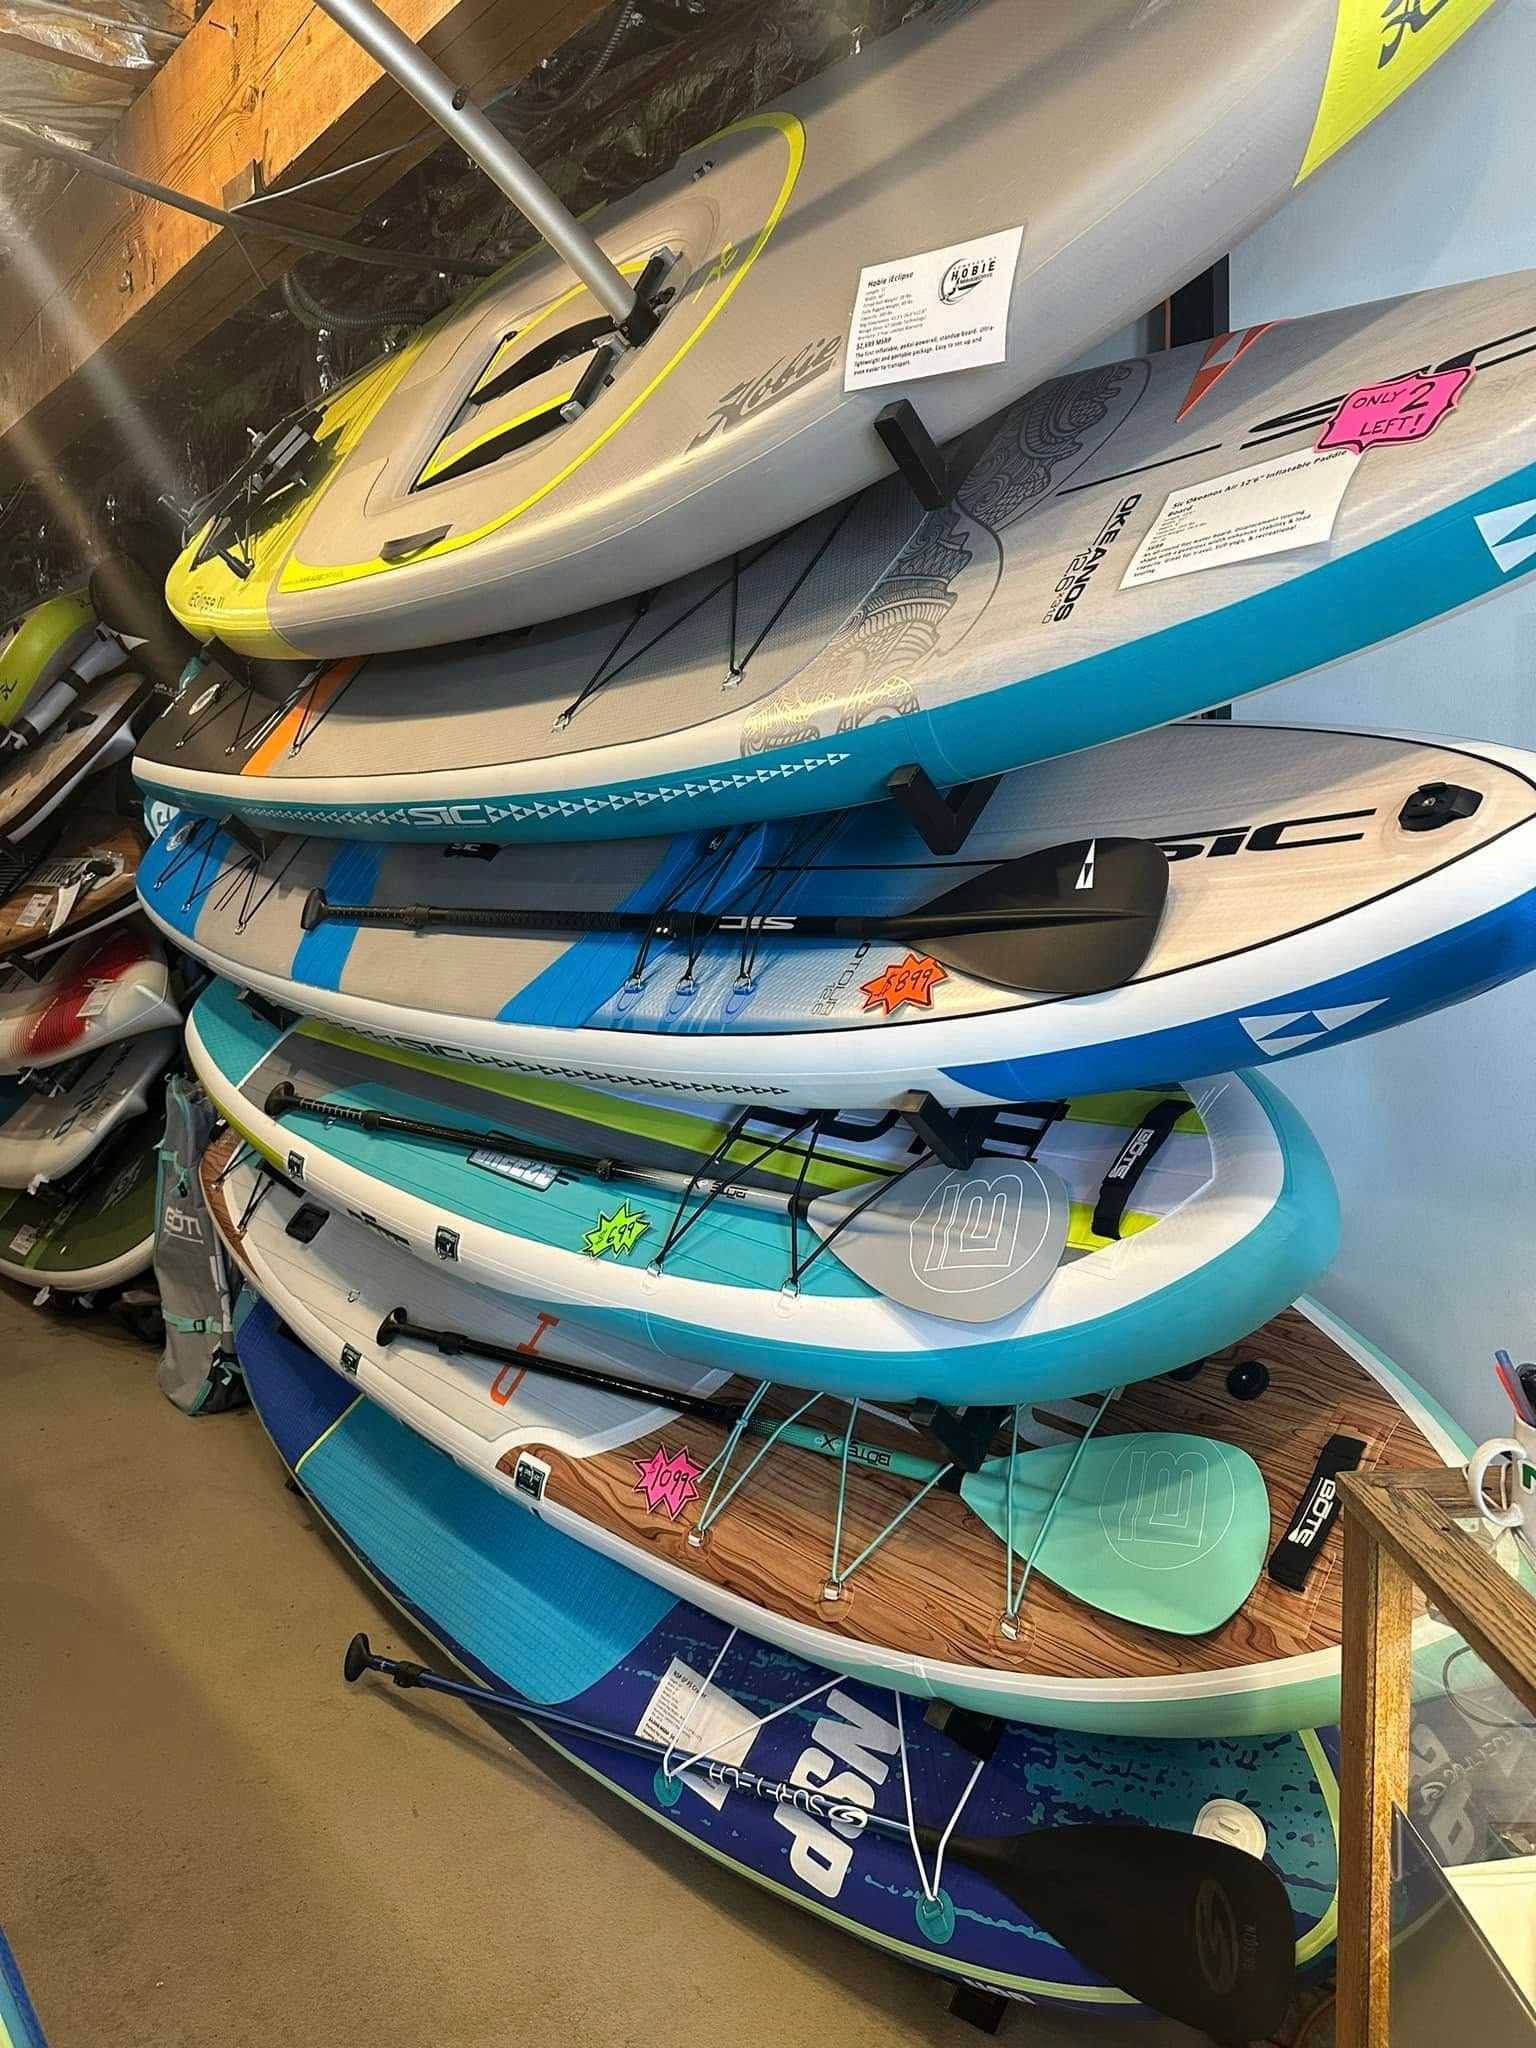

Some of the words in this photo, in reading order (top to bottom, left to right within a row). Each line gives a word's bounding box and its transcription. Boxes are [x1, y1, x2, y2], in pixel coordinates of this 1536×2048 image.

[951, 261, 996, 280] HOBIE
[1352, 388, 1406, 410] ONLY
[1398, 381, 1435, 414] 2
[1360, 414, 1423, 436] LEFT!
[1313, 449, 1348, 464] Paddle
[1054, 494, 1142, 621] OKEANOS
[407, 804, 488, 825] SIC
[718, 916, 799, 930] SIC
[396, 1037, 472, 1062] SIC
[773, 1688, 902, 1898] NSP
